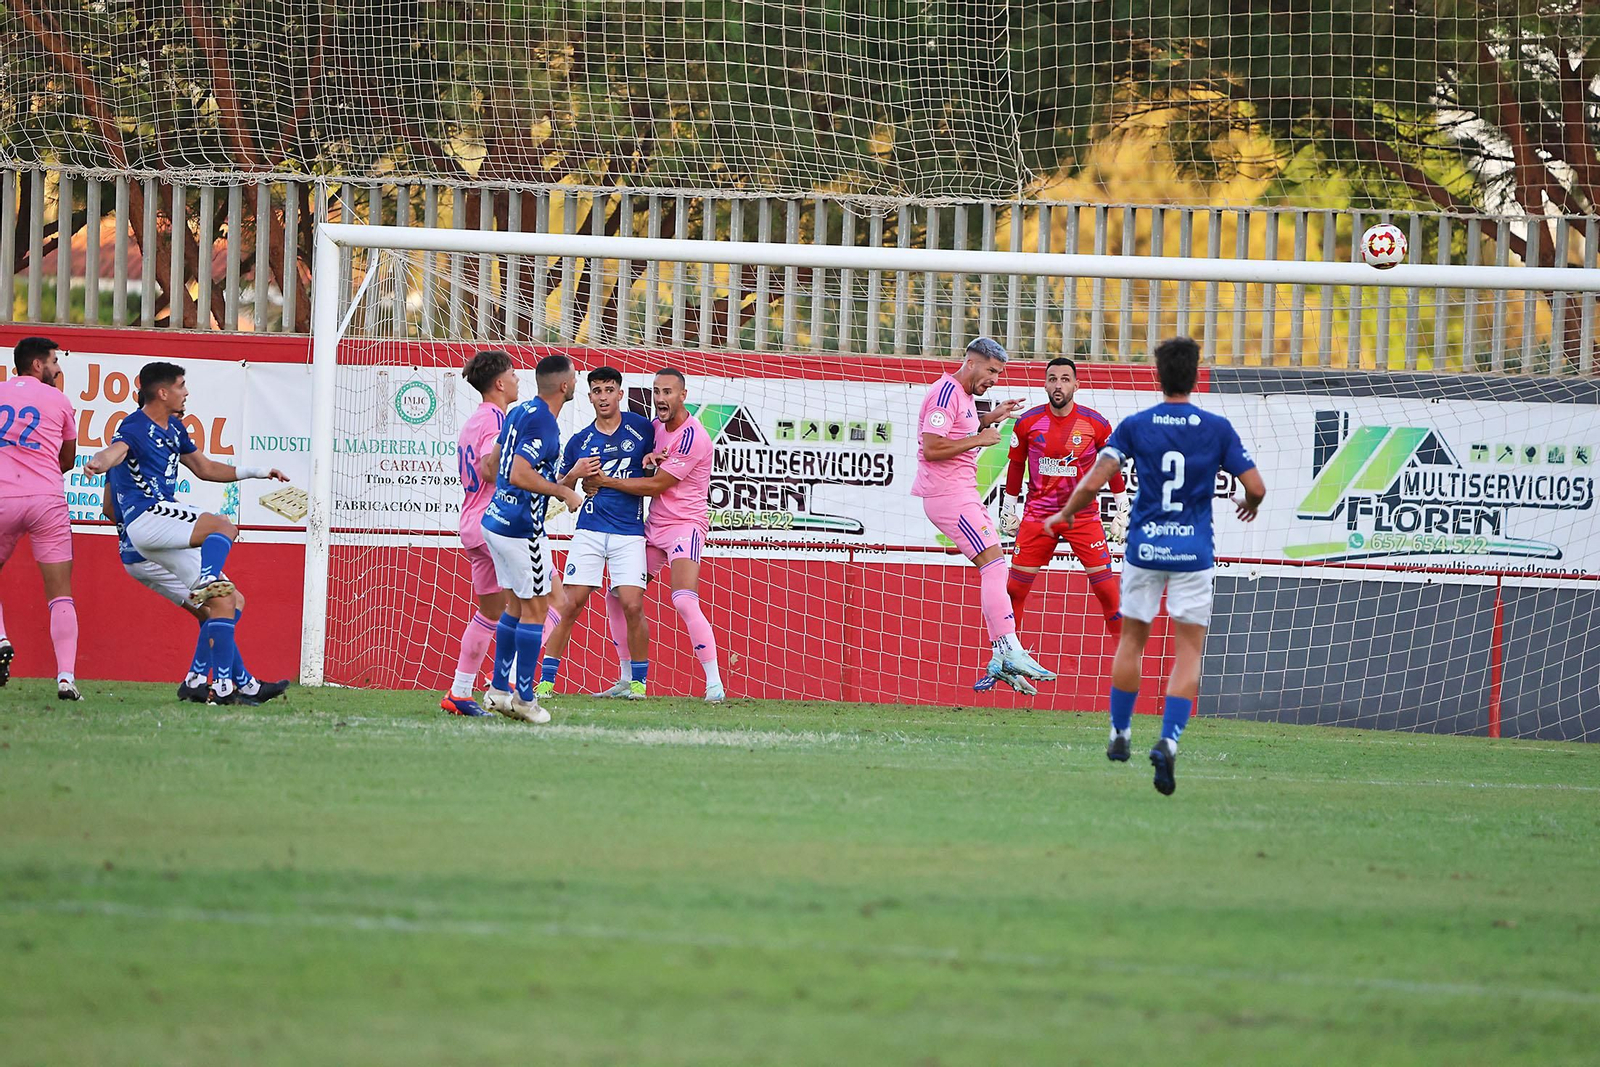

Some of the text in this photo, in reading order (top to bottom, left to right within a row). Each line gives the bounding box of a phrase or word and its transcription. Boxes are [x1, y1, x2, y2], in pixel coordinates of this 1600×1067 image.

[0, 404, 41, 449] 22
[345, 438, 428, 455] MADERERA
[431, 440, 456, 458] JOS
[380, 459, 444, 473] CARTAYA
[714, 448, 885, 478] MULTISERVICIOS
[365, 474, 395, 485] Tfno.
[397, 475, 418, 486] 626
[420, 475, 441, 486] 570
[1161, 450, 1186, 512] 2
[1404, 471, 1585, 502] MULTISERVICIOS
[335, 499, 461, 513] FABRICACIÓN DE PA
[707, 481, 806, 512] OREN
[721, 511, 755, 528] 654
[760, 511, 794, 529] 522
[1347, 496, 1501, 536] FLOREN
[1370, 533, 1489, 555] 657 654 522
